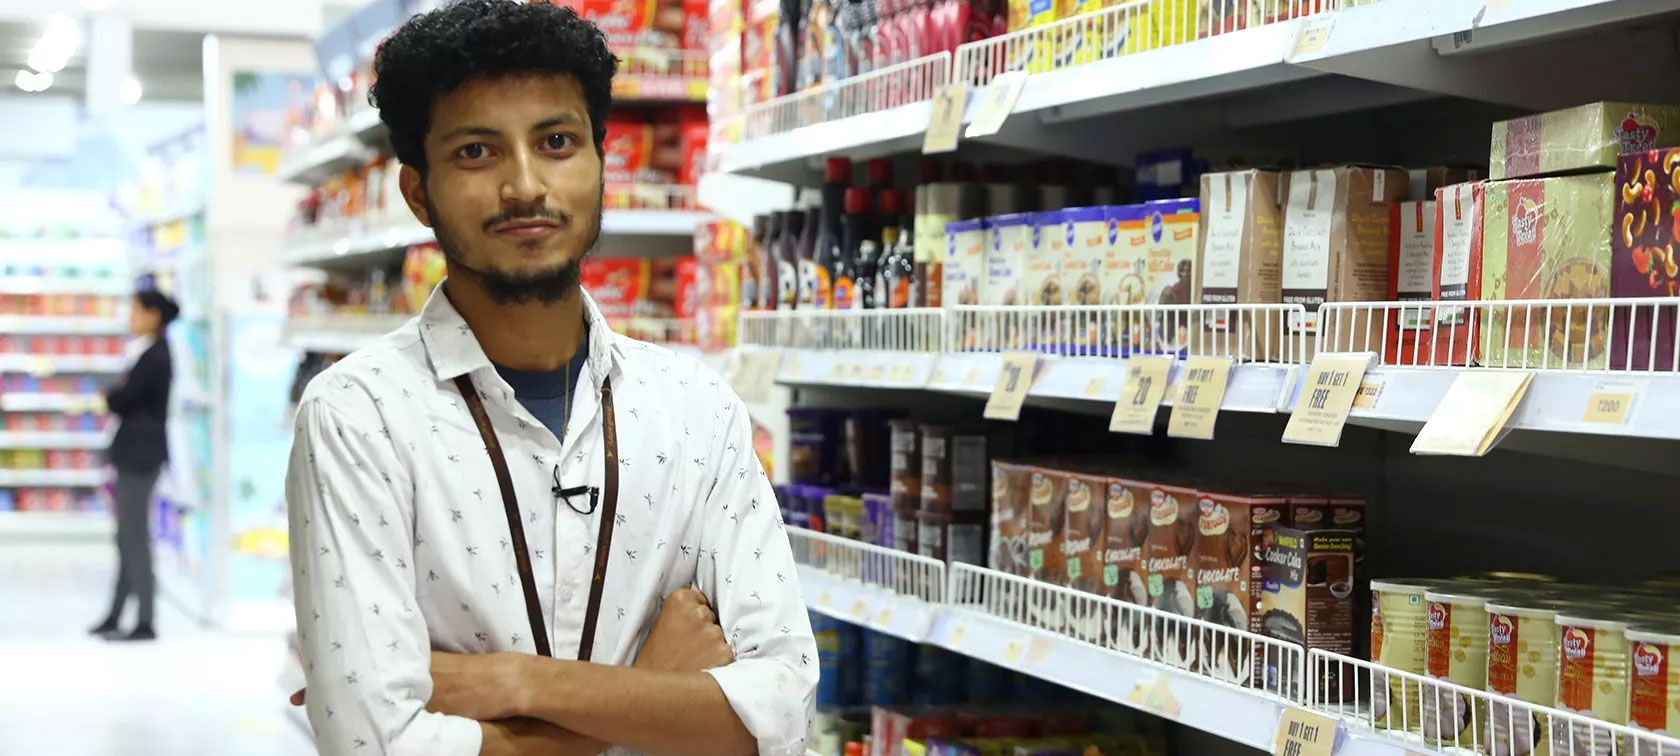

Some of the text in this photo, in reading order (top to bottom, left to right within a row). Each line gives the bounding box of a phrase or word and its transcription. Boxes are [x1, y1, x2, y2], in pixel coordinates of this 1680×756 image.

[1317, 371, 1329, 385] BUY
[1332, 372, 1344, 386] GET
[1343, 371, 1350, 386] 1
[1132, 376, 1152, 405] 20
[1182, 385, 1200, 404] FREE
[1309, 388, 1330, 409] FREE
[1105, 546, 1141, 562] CHOCOLATE
[1266, 546, 1302, 569] Cooker Cake
[1148, 556, 1187, 572] CHOCOLATE
[1198, 566, 1240, 584] CHOCOLATE
[1288, 721, 1319, 743] BUY 1 GET 1
[1283, 739, 1302, 756] FREE
